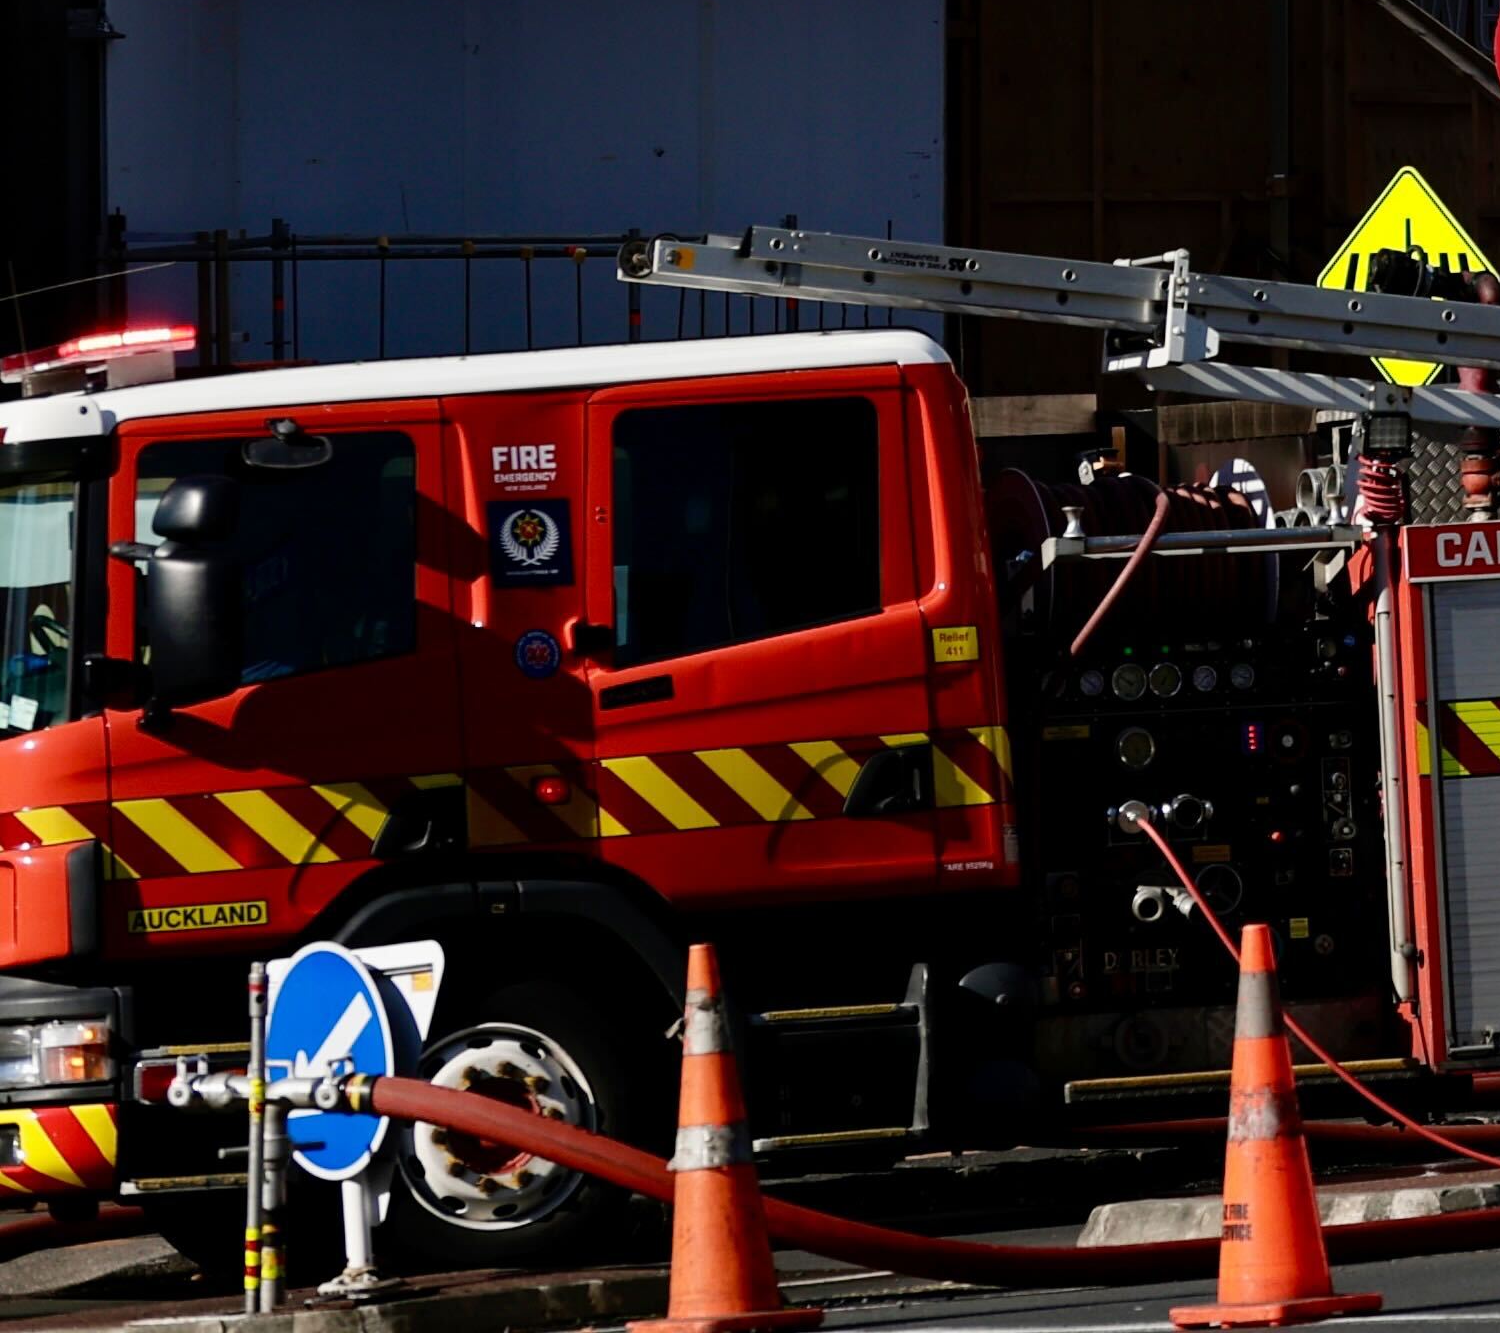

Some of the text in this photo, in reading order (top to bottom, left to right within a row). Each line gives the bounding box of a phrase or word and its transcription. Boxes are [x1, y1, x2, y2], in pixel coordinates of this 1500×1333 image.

[492, 445, 557, 471] FIRE
[494, 471, 557, 483] EMERGENCY
[939, 632, 969, 642] Relief
[945, 646, 963, 656] 411
[132, 903, 263, 931] AUCKLAND
